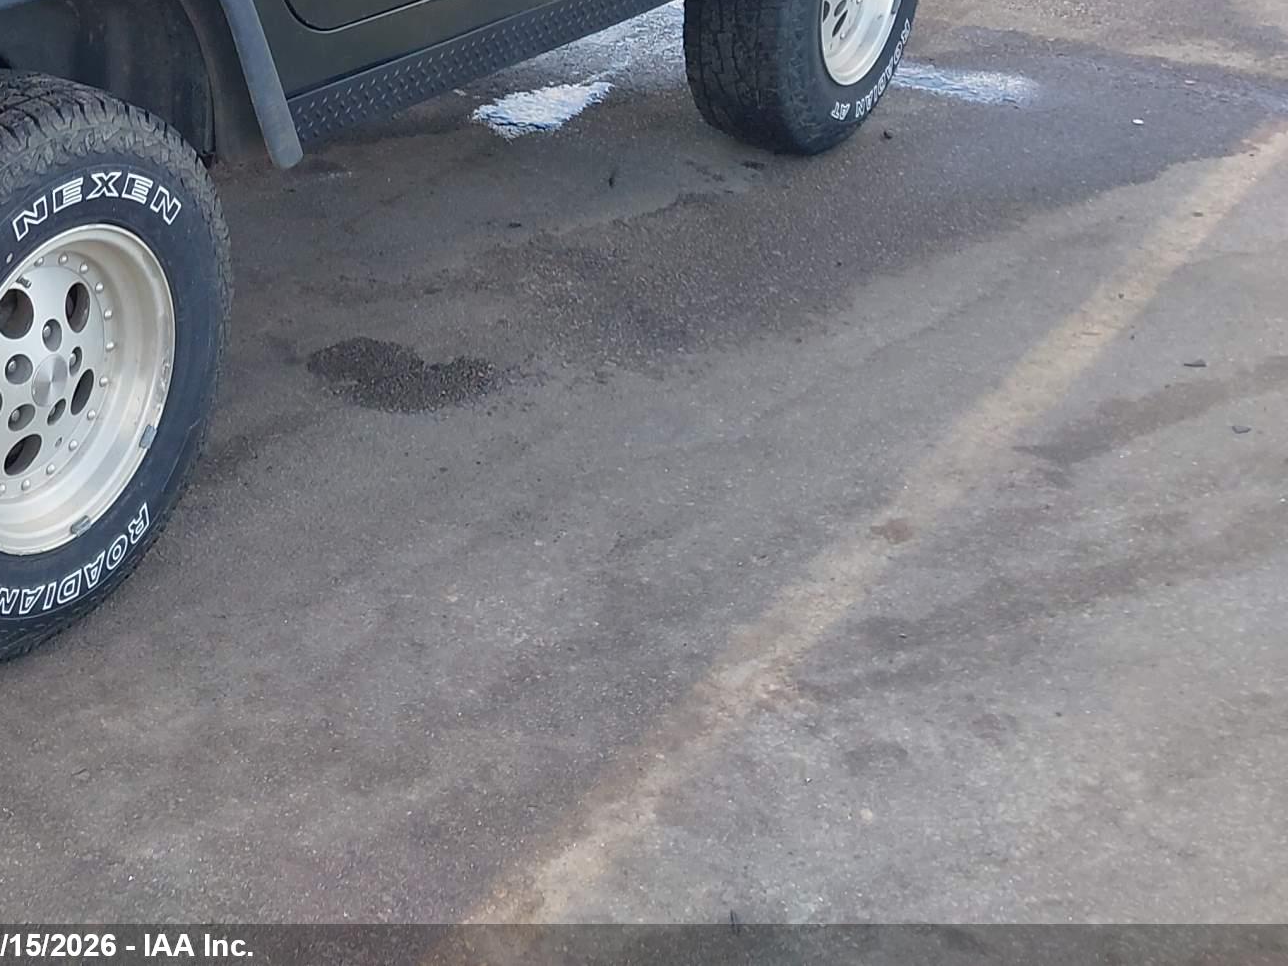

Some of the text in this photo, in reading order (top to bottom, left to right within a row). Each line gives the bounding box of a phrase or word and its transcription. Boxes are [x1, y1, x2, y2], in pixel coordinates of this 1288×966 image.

[830, 19, 911, 121] ROADIAN AT
[12, 171, 182, 242] NEXEN
